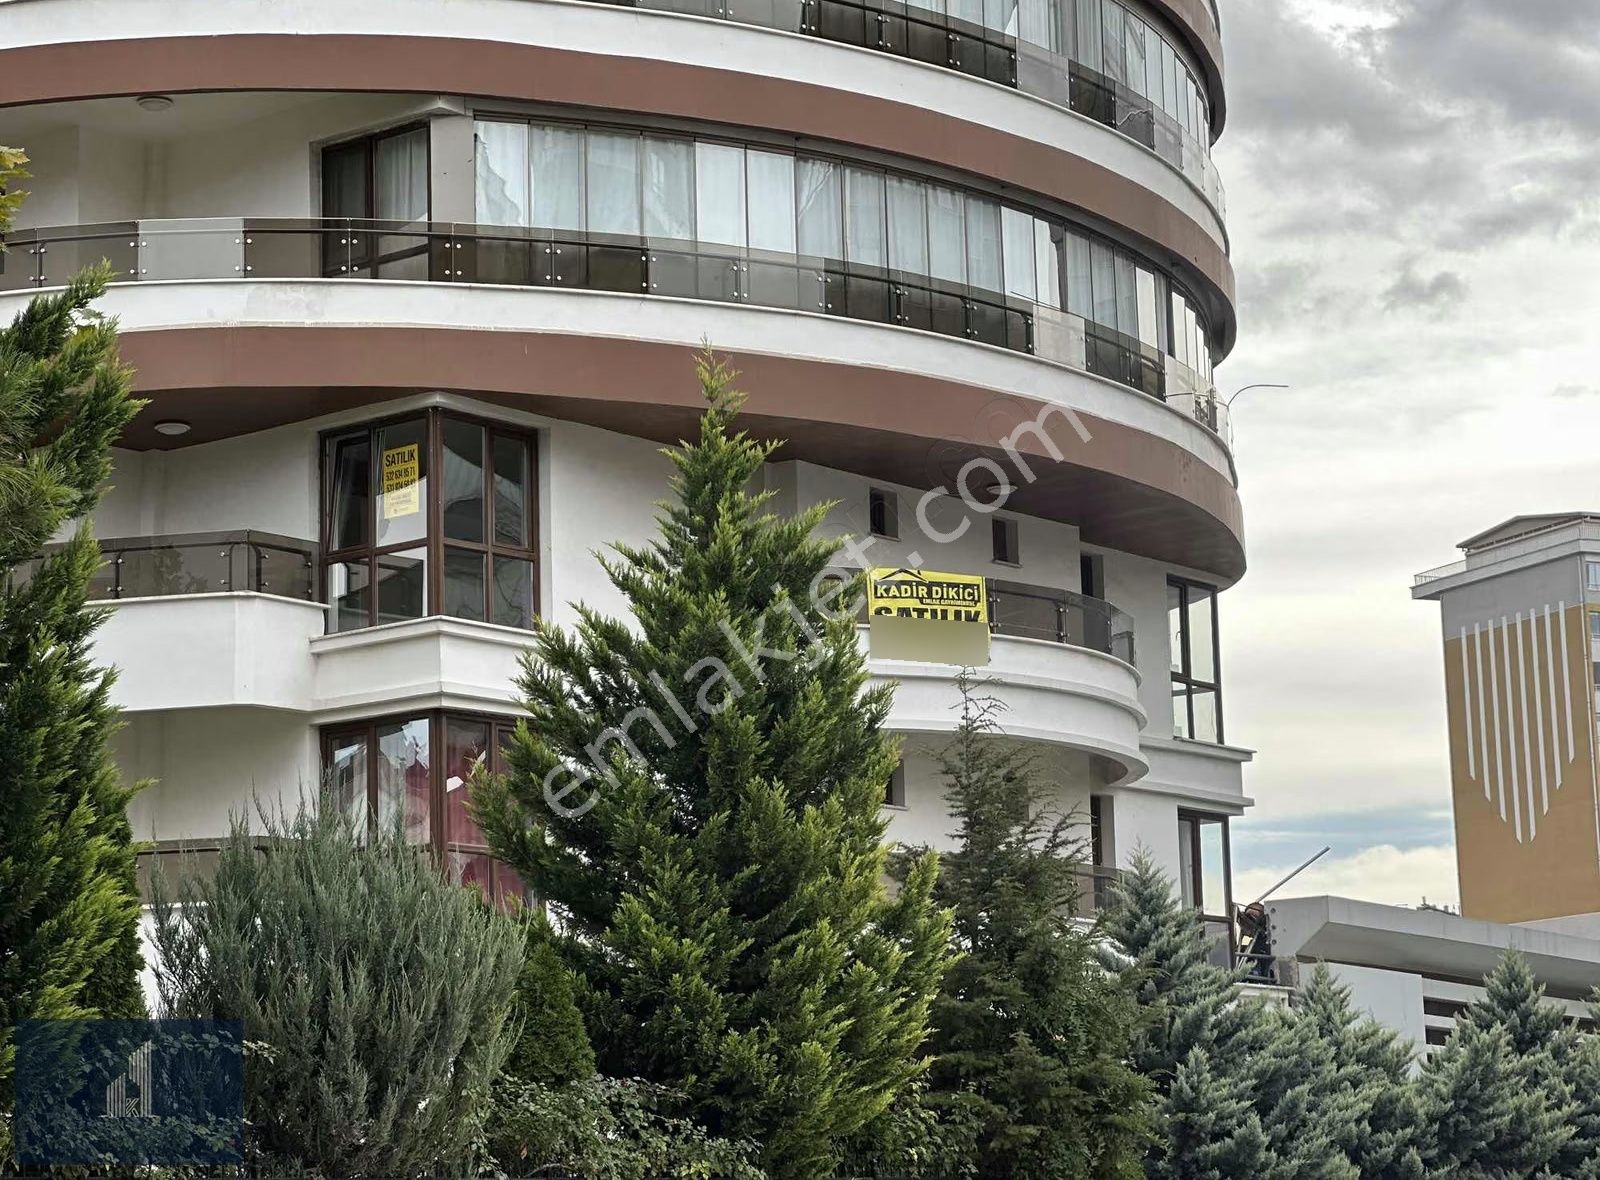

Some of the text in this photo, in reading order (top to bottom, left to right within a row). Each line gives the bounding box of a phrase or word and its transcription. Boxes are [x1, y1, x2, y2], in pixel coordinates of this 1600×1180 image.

[385, 450, 415, 467] SATILIK
[877, 582, 978, 600] KADİR DİKİCİ
